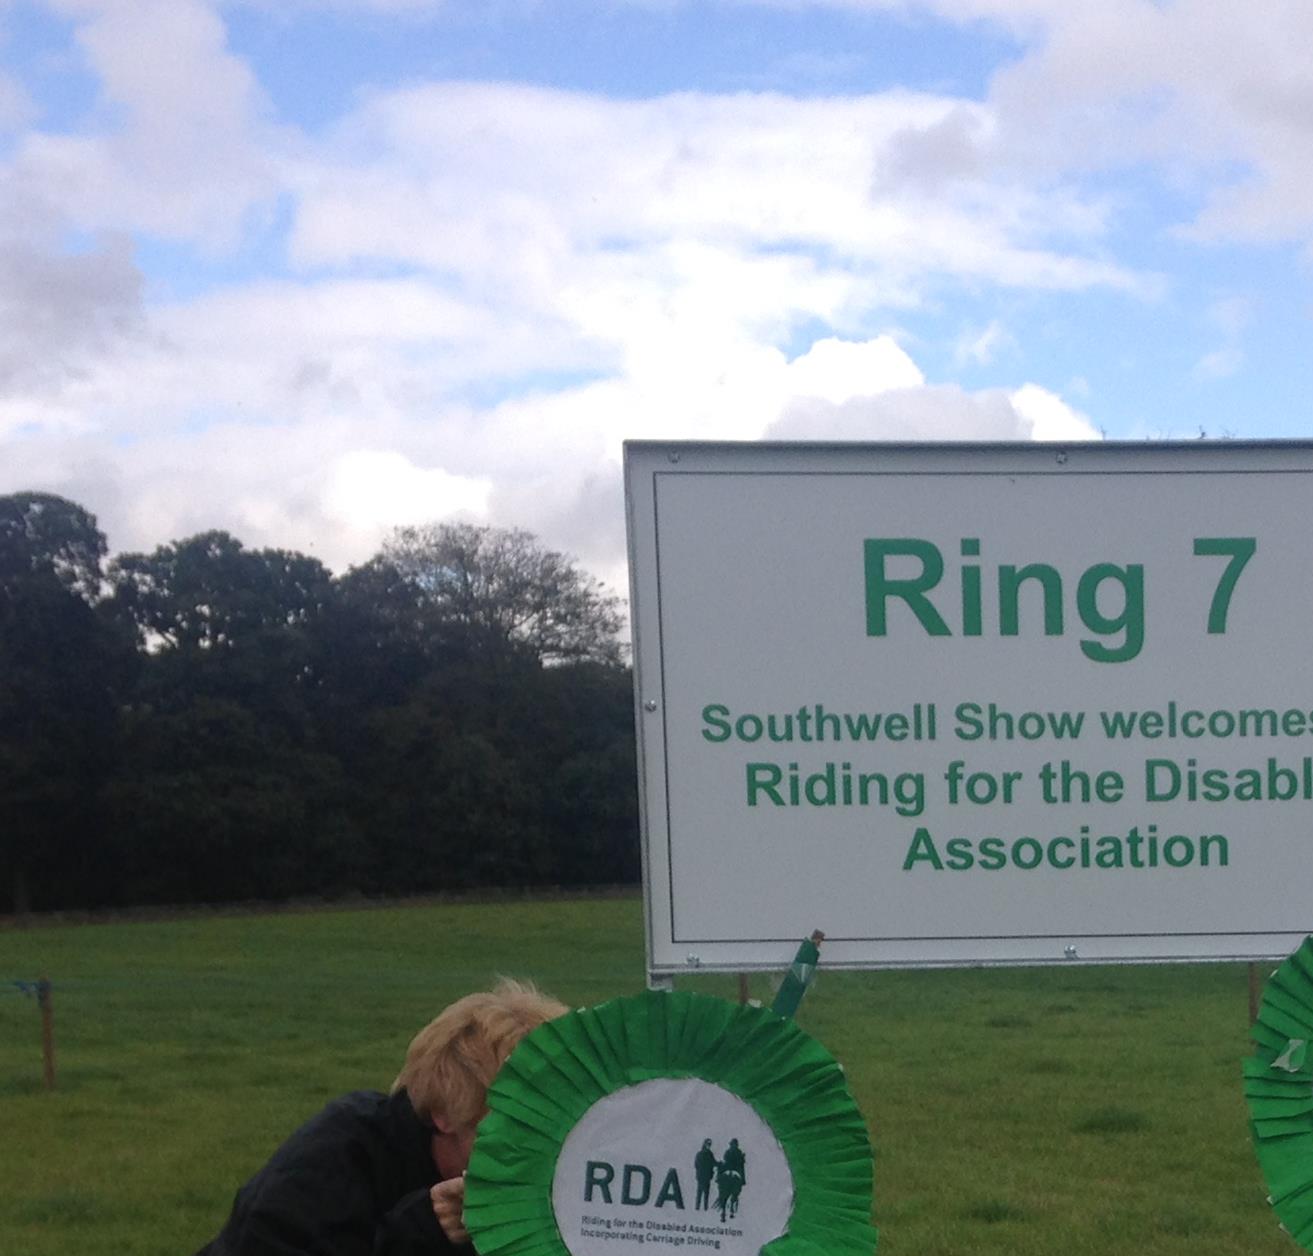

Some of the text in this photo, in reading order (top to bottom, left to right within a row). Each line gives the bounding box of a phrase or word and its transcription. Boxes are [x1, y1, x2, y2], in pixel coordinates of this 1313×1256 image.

[864, 538, 1257, 664] Ring 7
[701, 703, 937, 743] Southwell
[954, 702, 1085, 740] Show
[746, 761, 925, 817] Riding
[945, 760, 1023, 804] for
[1040, 759, 1125, 802] the
[902, 827, 1230, 872] Association
[583, 1160, 685, 1210] RDA
[580, 1228, 720, 1249] Incorporating Carriage Driving
[581, 1215, 743, 1237] Riding for the Disabled Association
